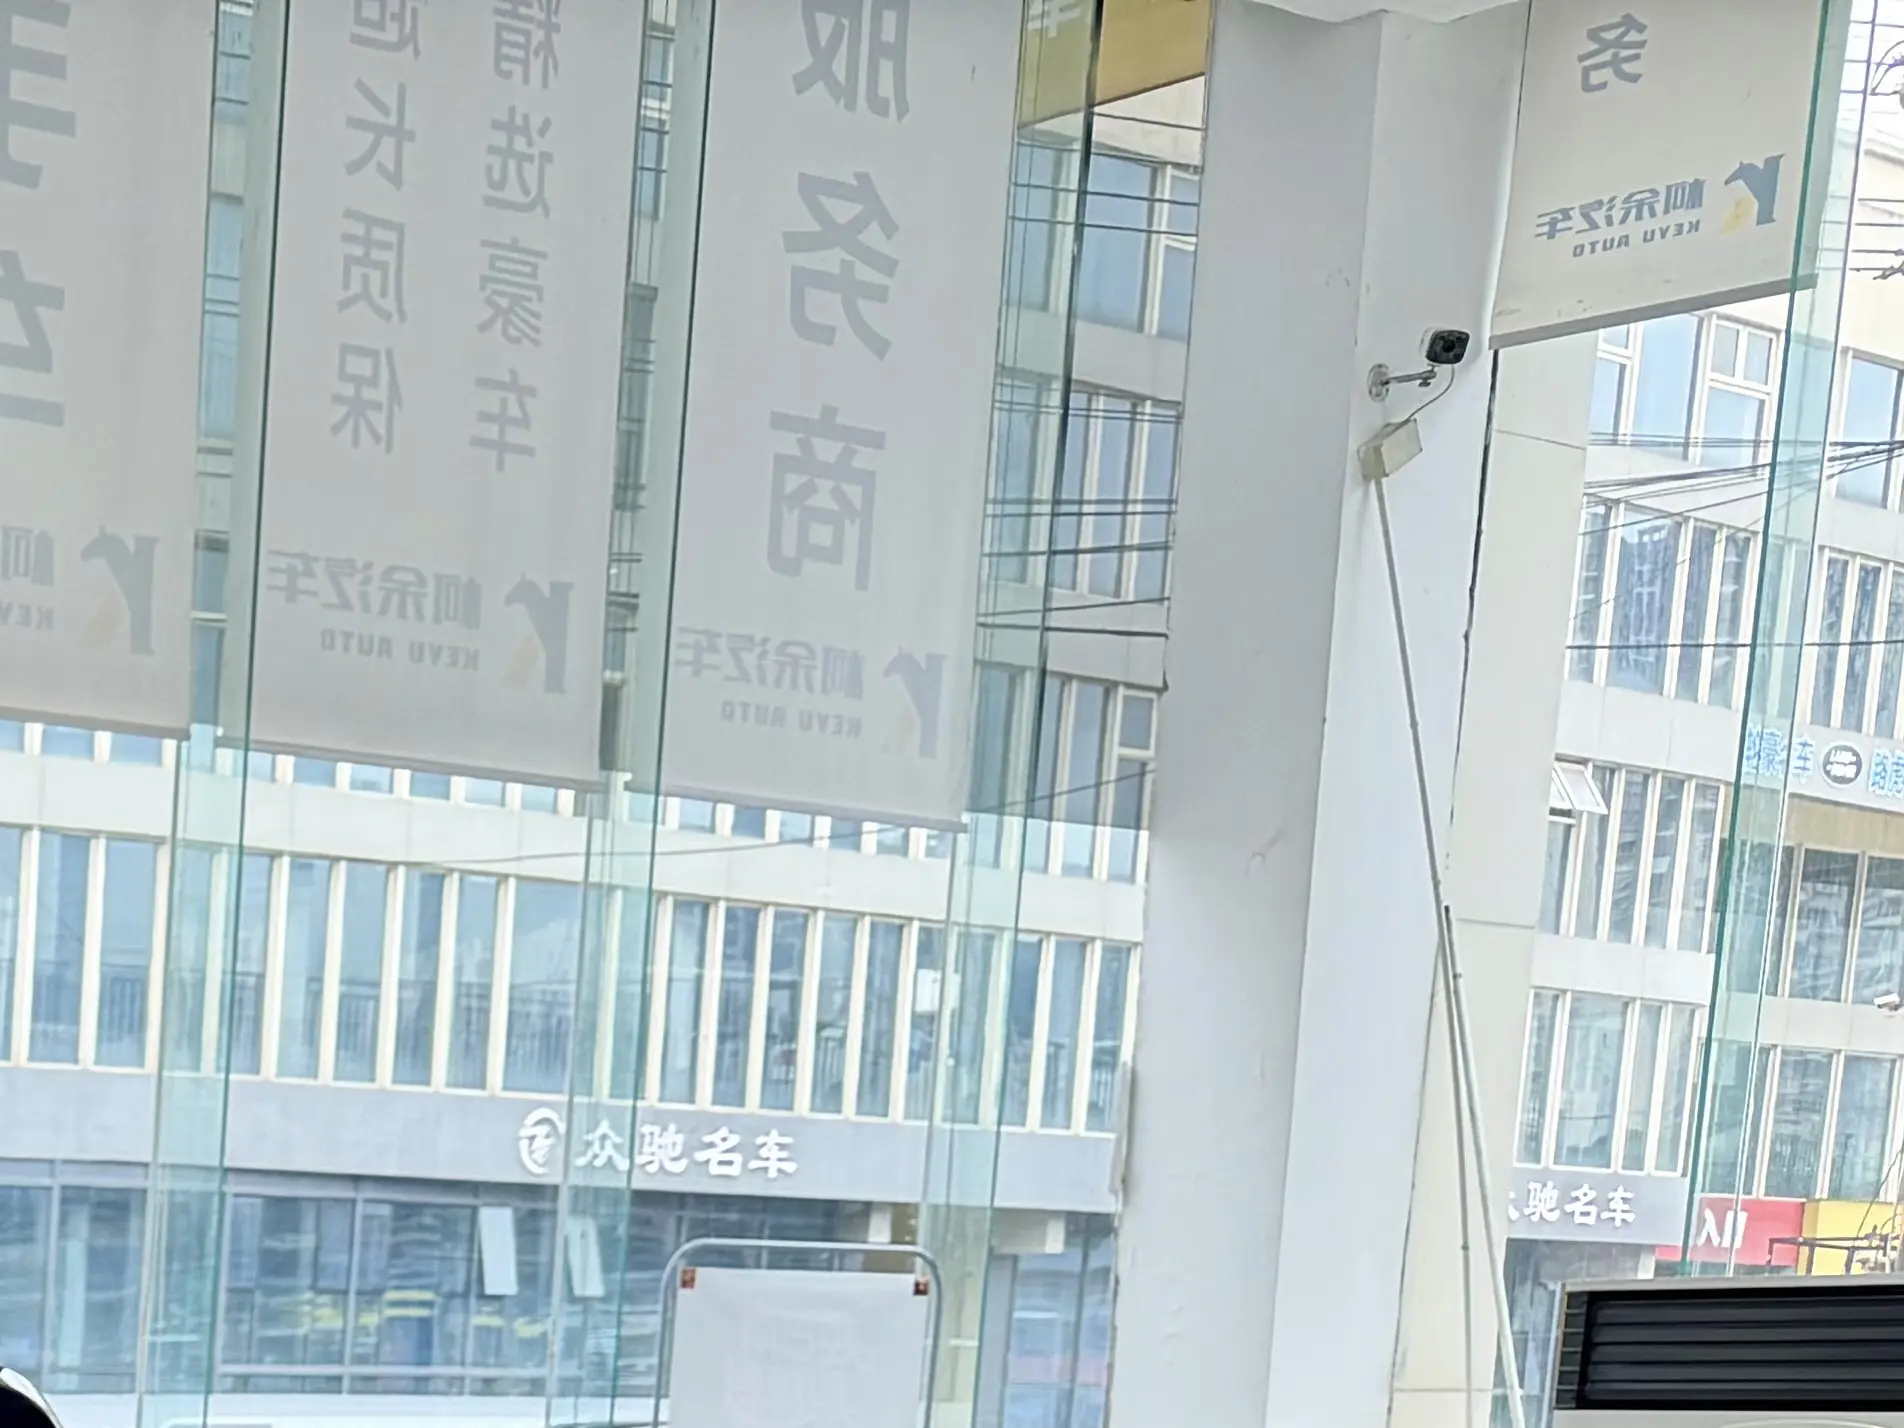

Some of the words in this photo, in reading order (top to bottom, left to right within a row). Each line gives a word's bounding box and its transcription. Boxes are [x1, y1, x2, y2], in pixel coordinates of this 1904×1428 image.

[575, 1118, 799, 1179] 众驰名车
[1508, 1181, 1635, 1228] 驰名车
